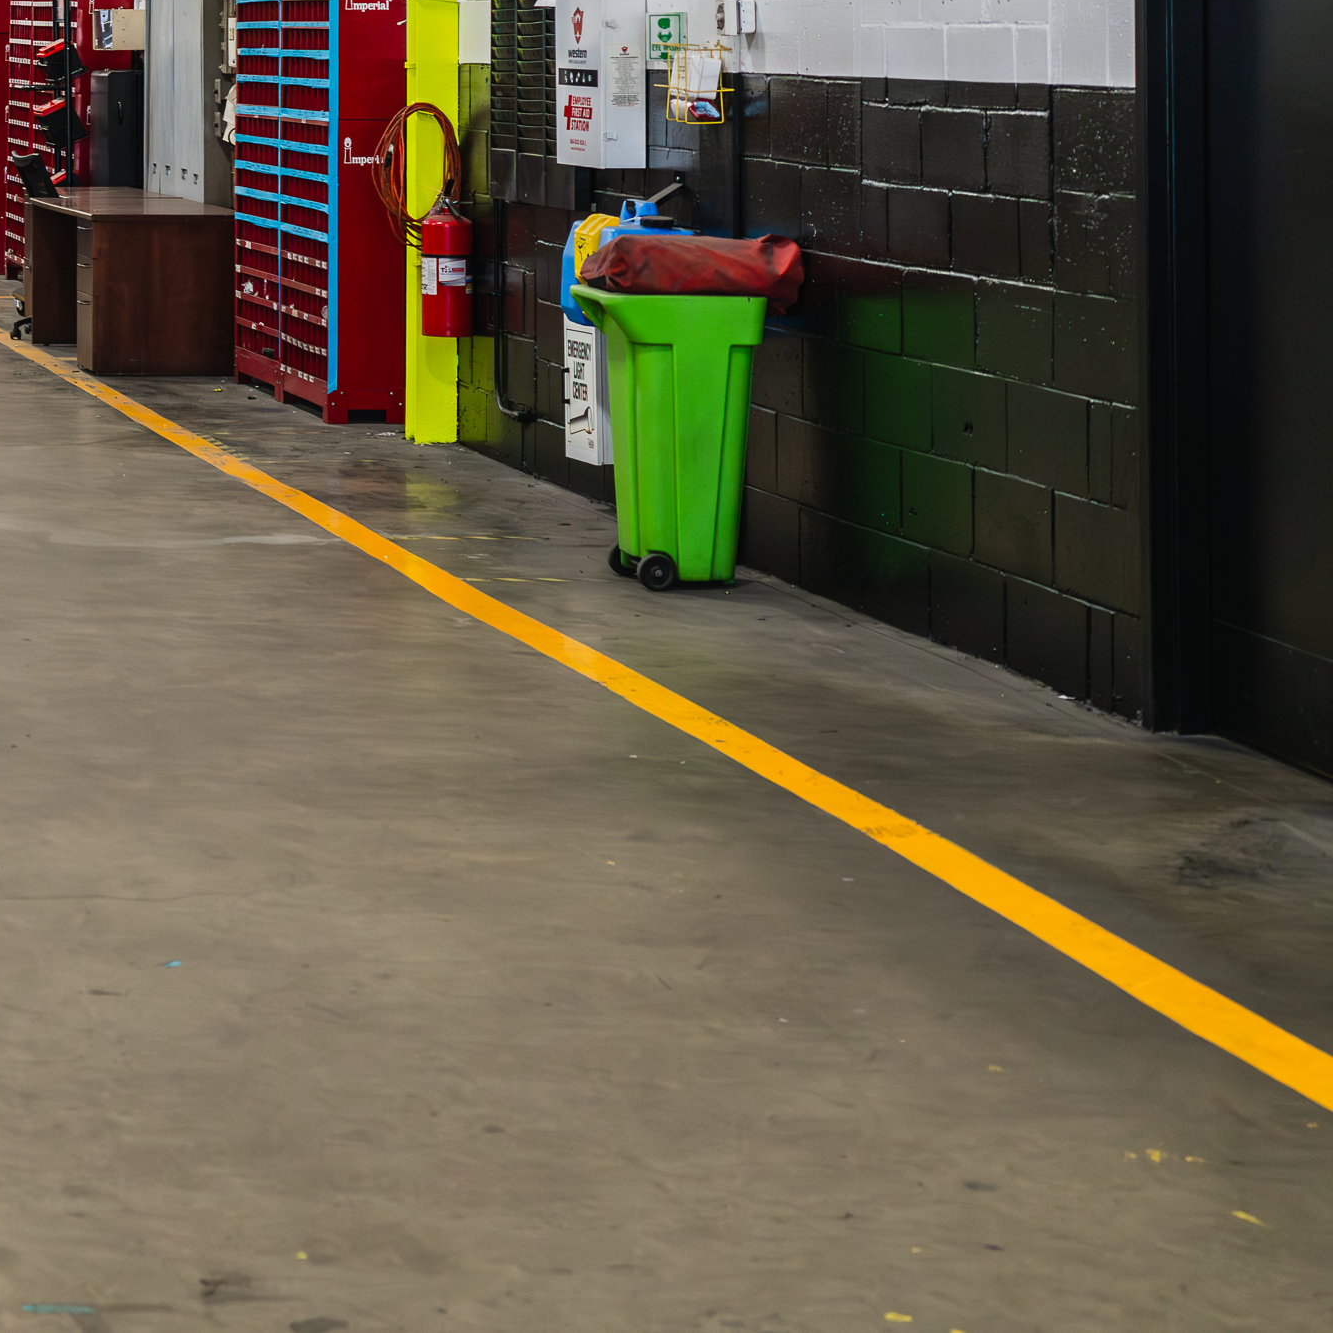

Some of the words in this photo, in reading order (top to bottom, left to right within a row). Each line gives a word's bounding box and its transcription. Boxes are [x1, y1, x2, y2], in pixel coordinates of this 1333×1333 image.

[568, 48, 588, 59] western
[573, 96, 591, 106] EMPLOYEE
[572, 107, 582, 117] FIRST
[571, 120, 589, 132] STATION
[568, 339, 591, 361] EMERGENCY
[573, 361, 585, 380] LIGHT
[573, 381, 588, 402] CENTER
